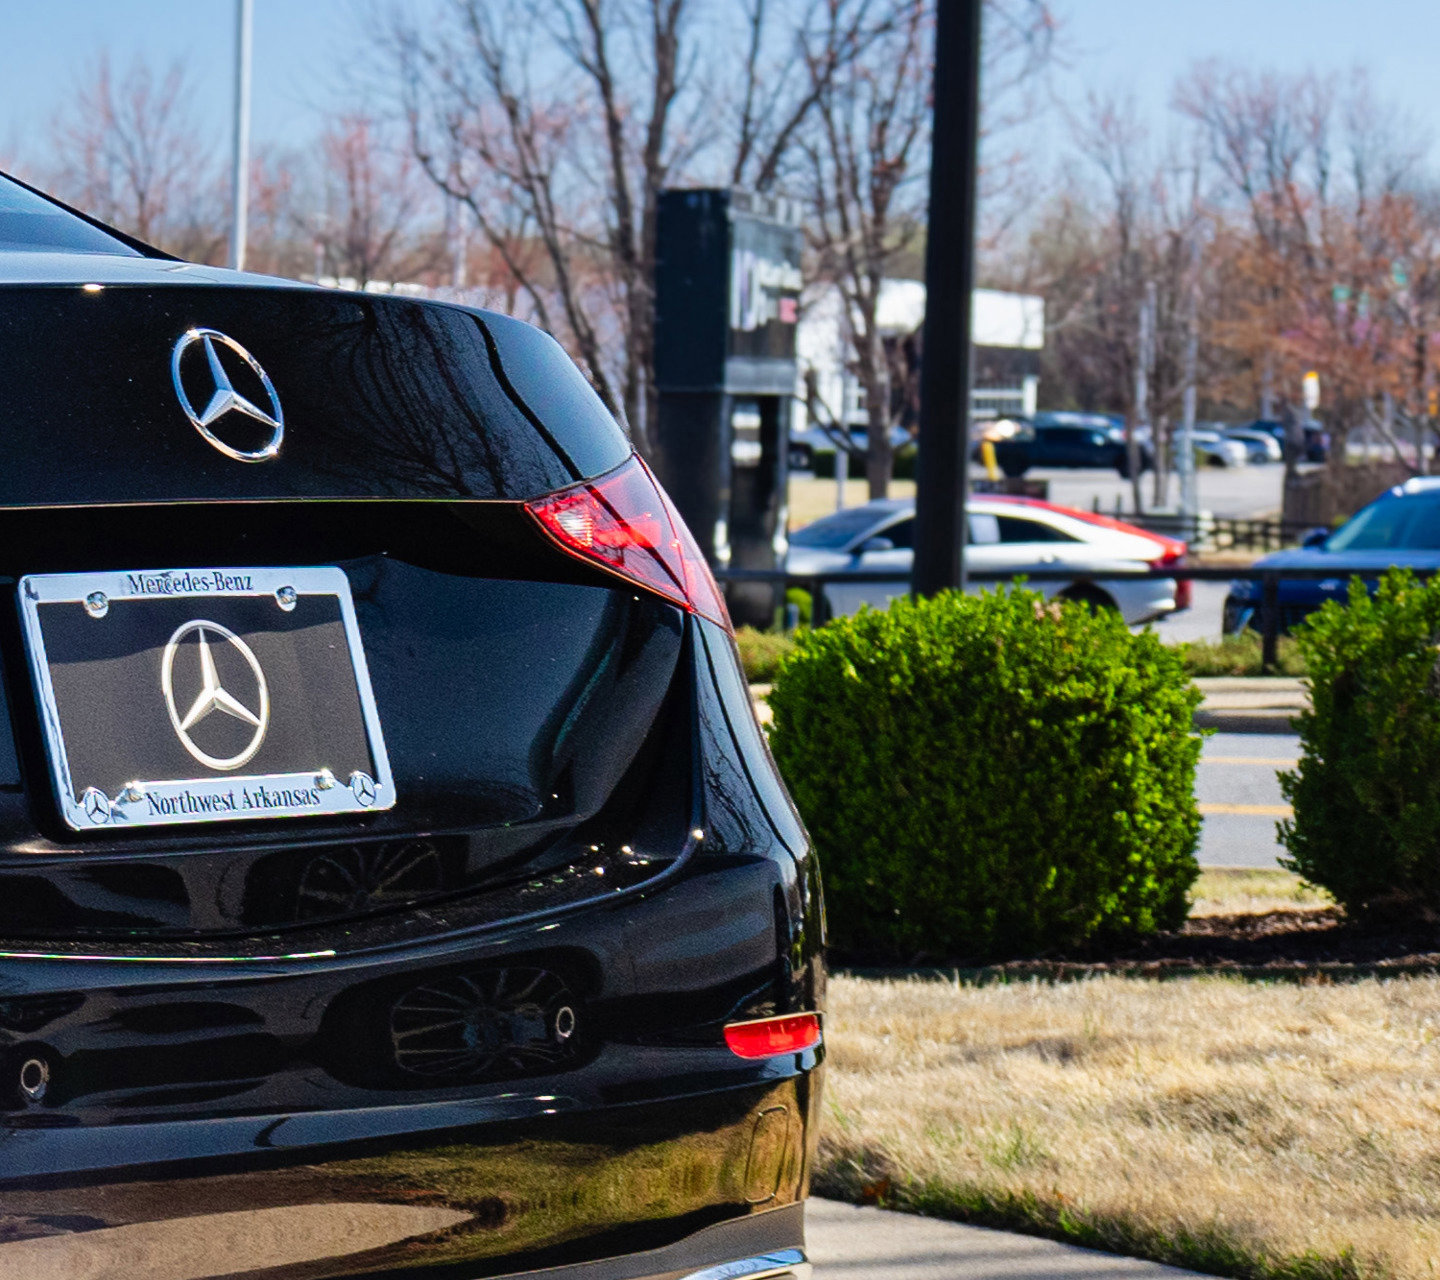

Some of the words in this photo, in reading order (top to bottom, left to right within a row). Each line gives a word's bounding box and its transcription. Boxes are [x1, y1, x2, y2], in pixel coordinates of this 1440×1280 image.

[128, 571, 255, 596] Mercedes-Benz
[147, 789, 238, 817] Northwest
[242, 785, 321, 810] Arkansas
